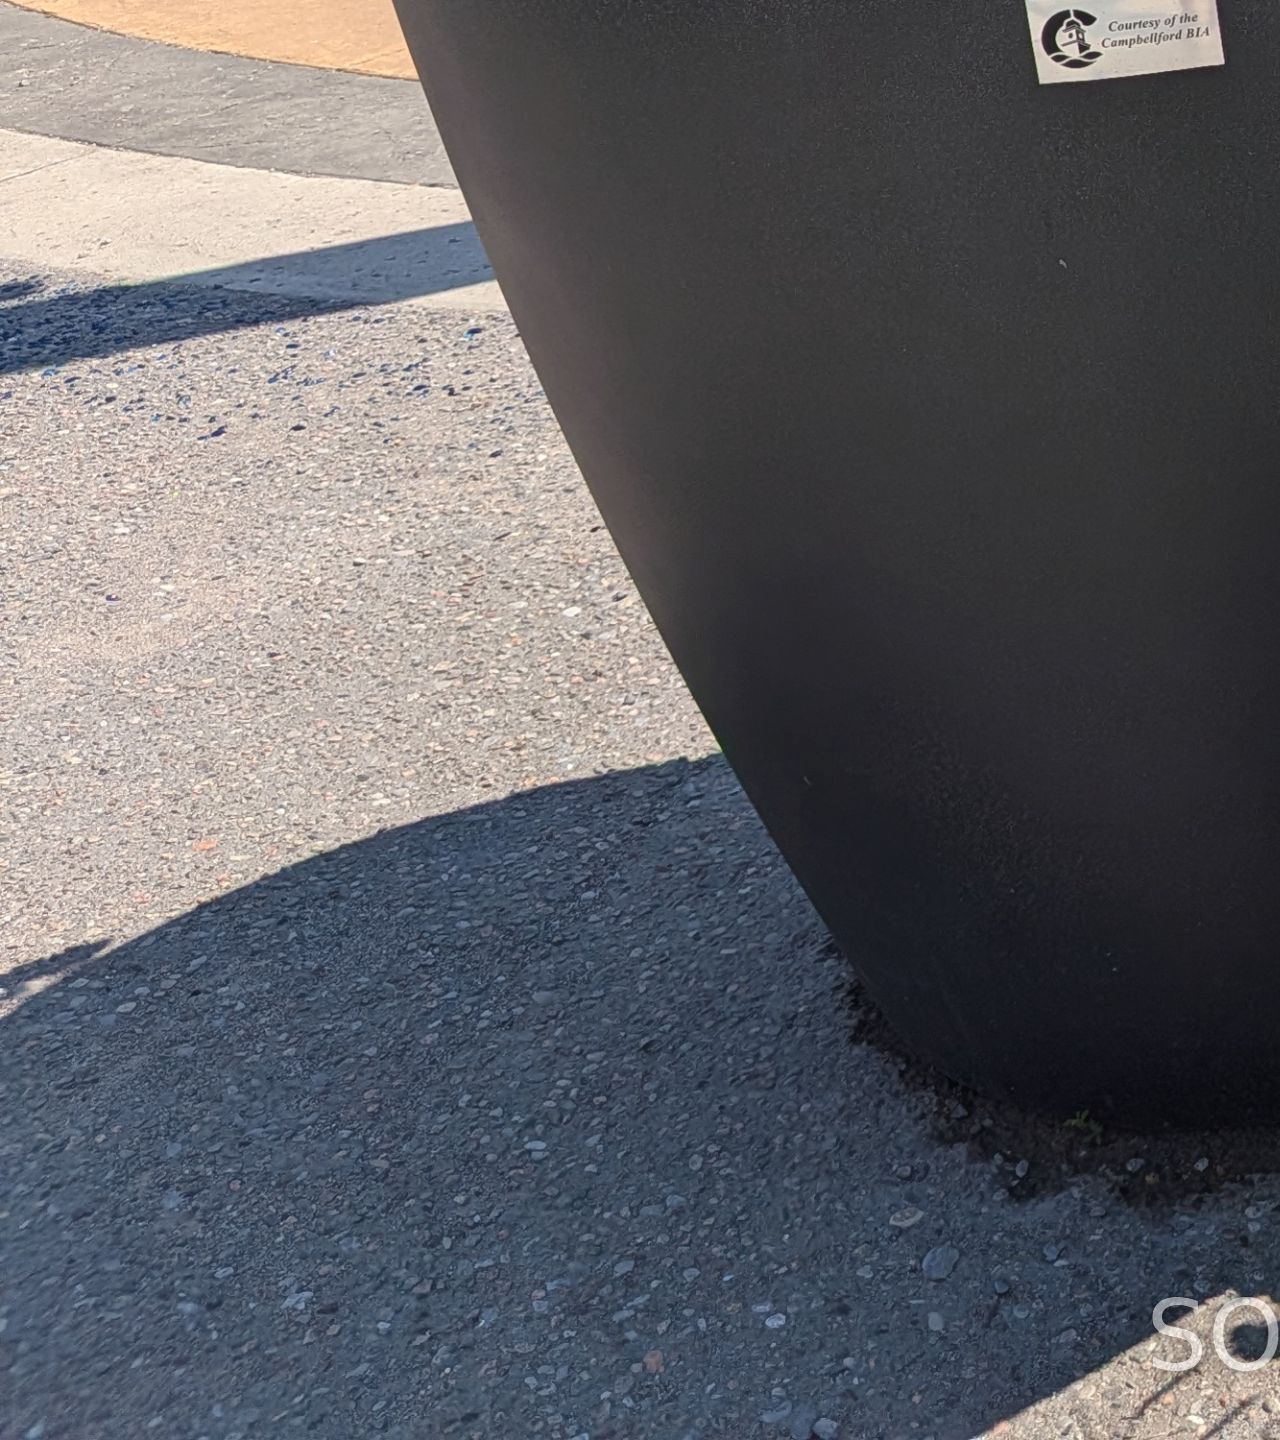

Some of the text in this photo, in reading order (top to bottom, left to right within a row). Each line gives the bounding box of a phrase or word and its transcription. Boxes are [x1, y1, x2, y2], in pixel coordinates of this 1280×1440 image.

[1108, 12, 1199, 33] Courtesy of the
[1101, 26, 1210, 49] Campbellford BIA
